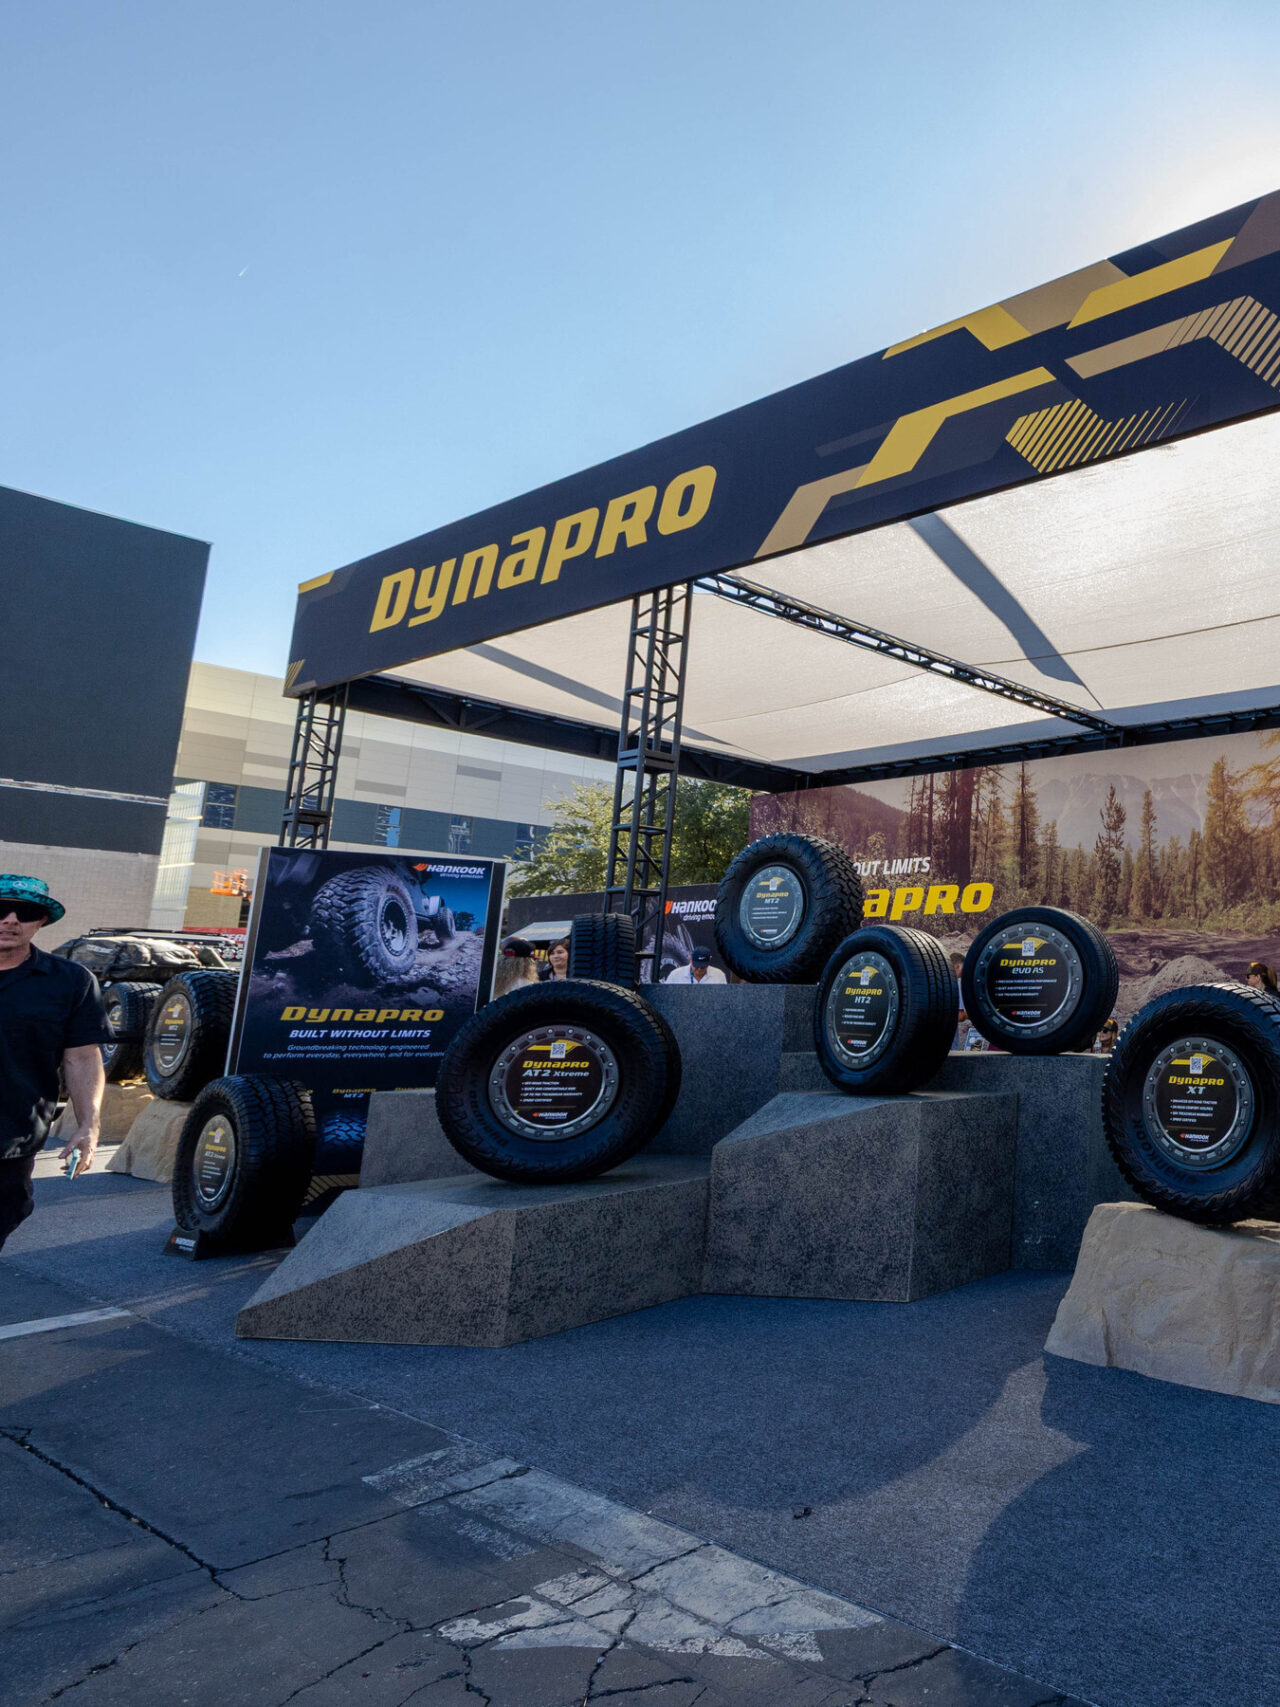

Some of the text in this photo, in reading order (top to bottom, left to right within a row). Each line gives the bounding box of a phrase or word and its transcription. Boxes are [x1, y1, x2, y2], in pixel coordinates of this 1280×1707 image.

[883, 856, 931, 875] LIMITS
[854, 996, 871, 1004] HT2
[289, 1029, 431, 1039] BUILT WITHOUT LIMITS
[287, 1044, 347, 1052] Groundbreaking
[348, 1044, 388, 1052] technology
[272, 1052, 305, 1060] perform
[522, 1069, 551, 1077] AT2
[1186, 1086, 1206, 1095] XT
